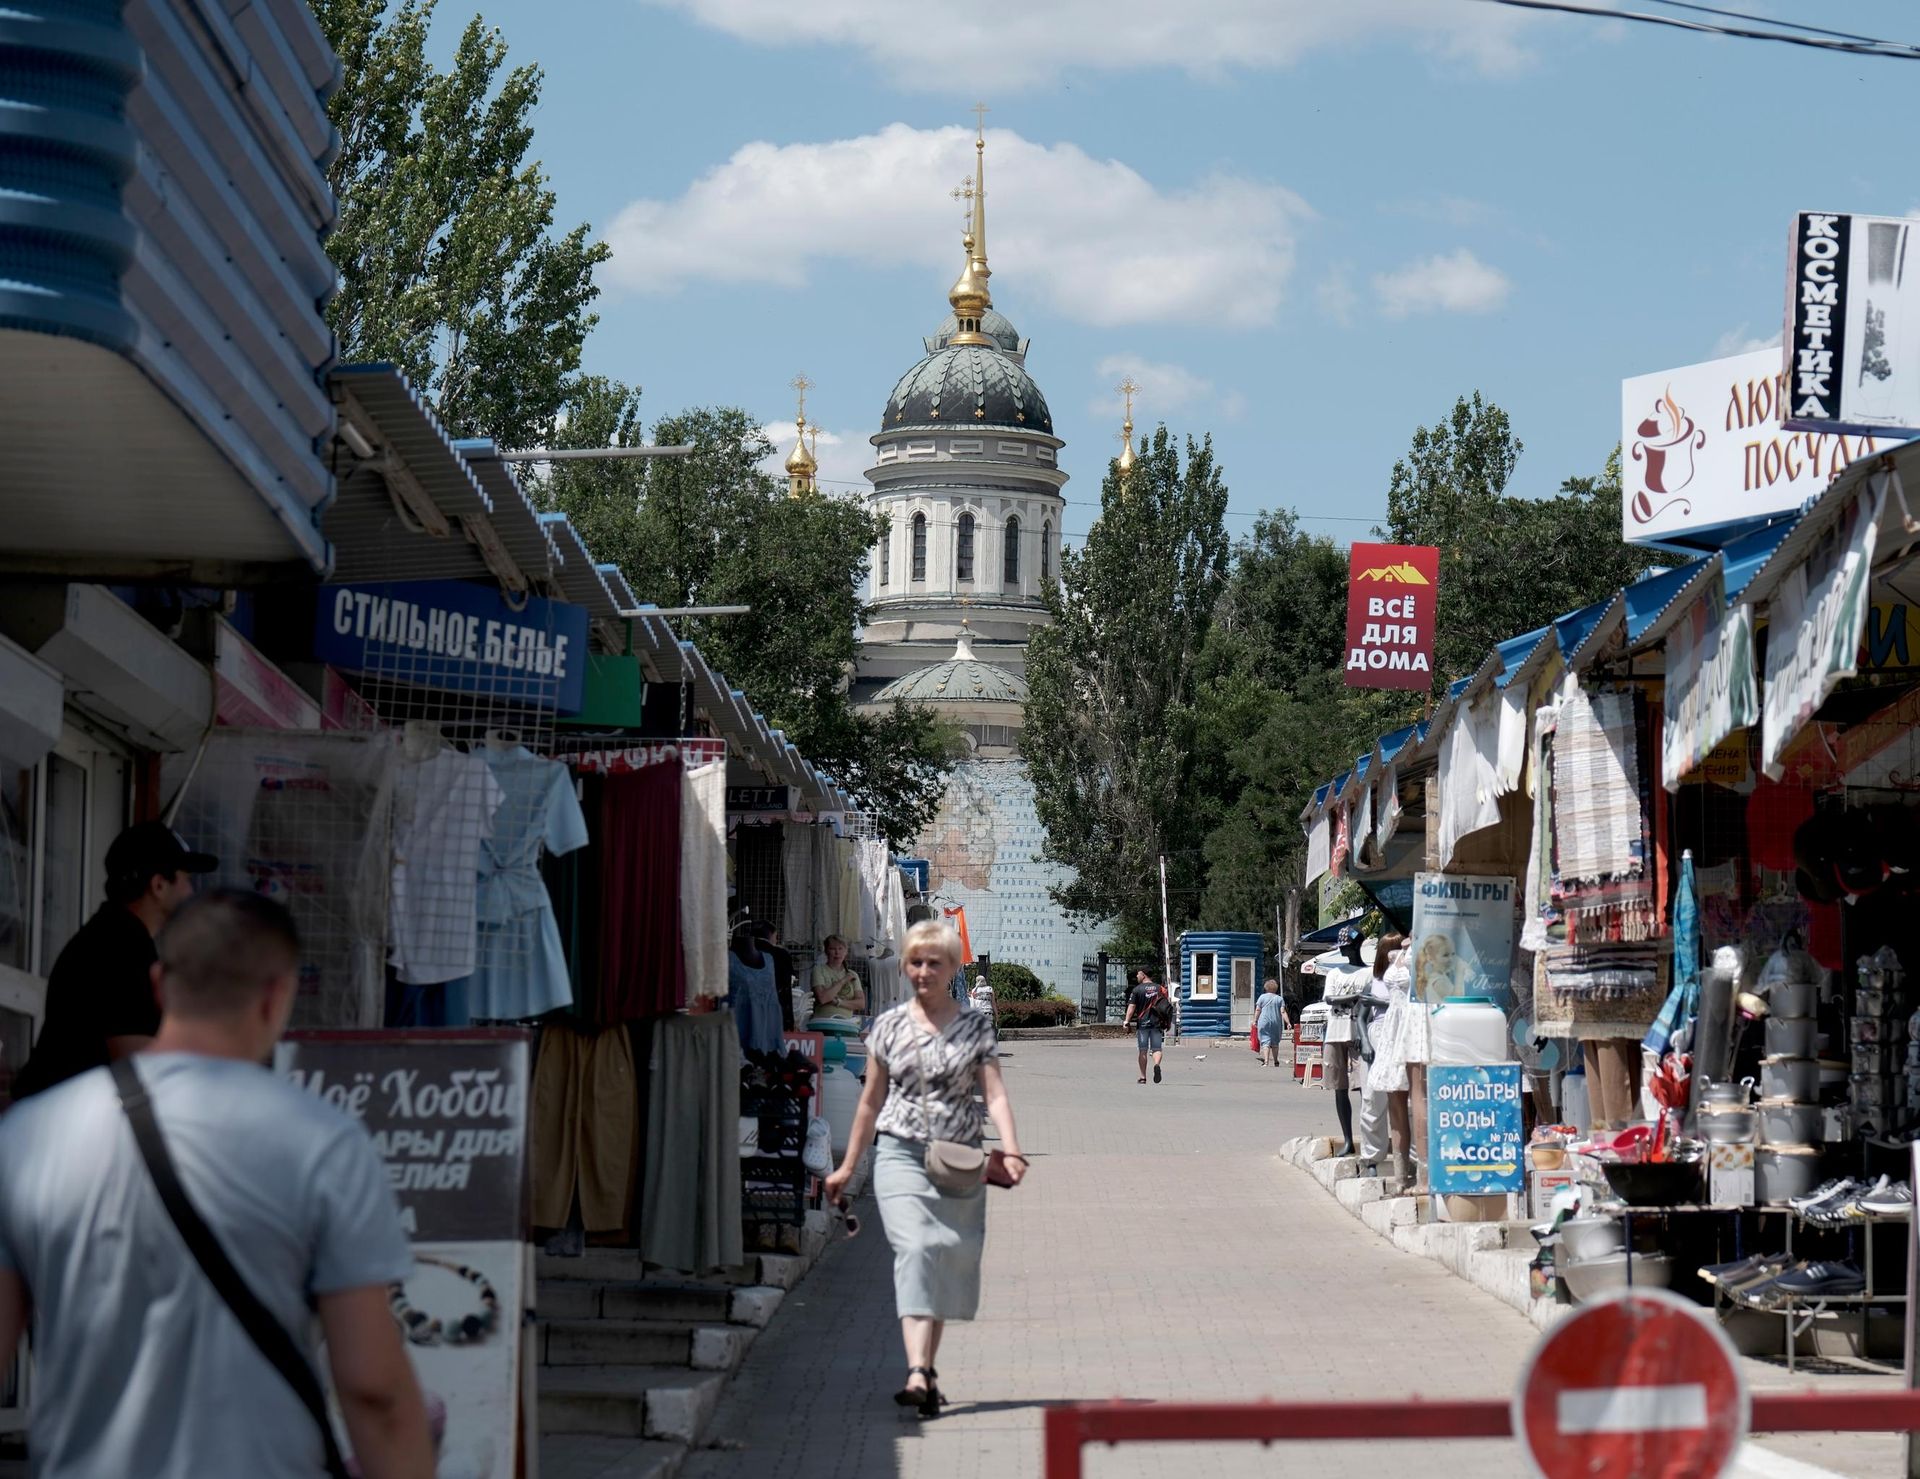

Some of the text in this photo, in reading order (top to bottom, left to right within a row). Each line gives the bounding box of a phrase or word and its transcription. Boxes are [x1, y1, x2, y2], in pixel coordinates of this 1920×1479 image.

[1794, 214, 1840, 418] КОСМЕТИКА
[1725, 374, 1784, 432] ЛЮ
[1367, 594, 1416, 619] ВСЁ
[333, 587, 569, 679] СТИЛЬНОЕ БЕЛЬЕ
[1361, 623, 1418, 646] ДЛЯ
[1346, 648, 1430, 672] ДОМА
[1421, 880, 1509, 901] ФИЛЬТРЫ
[380, 1068, 518, 1119] Хобби
[1438, 1082, 1519, 1100] ФИЛЬТРЫ
[1439, 1111, 1496, 1131] ВОДЫ
[371, 1128, 520, 1162] АРЫ ДЛЯ
[1440, 1145, 1517, 1161] НАСОСЫ
[384, 1162, 471, 1190] ЕЛИЯ
